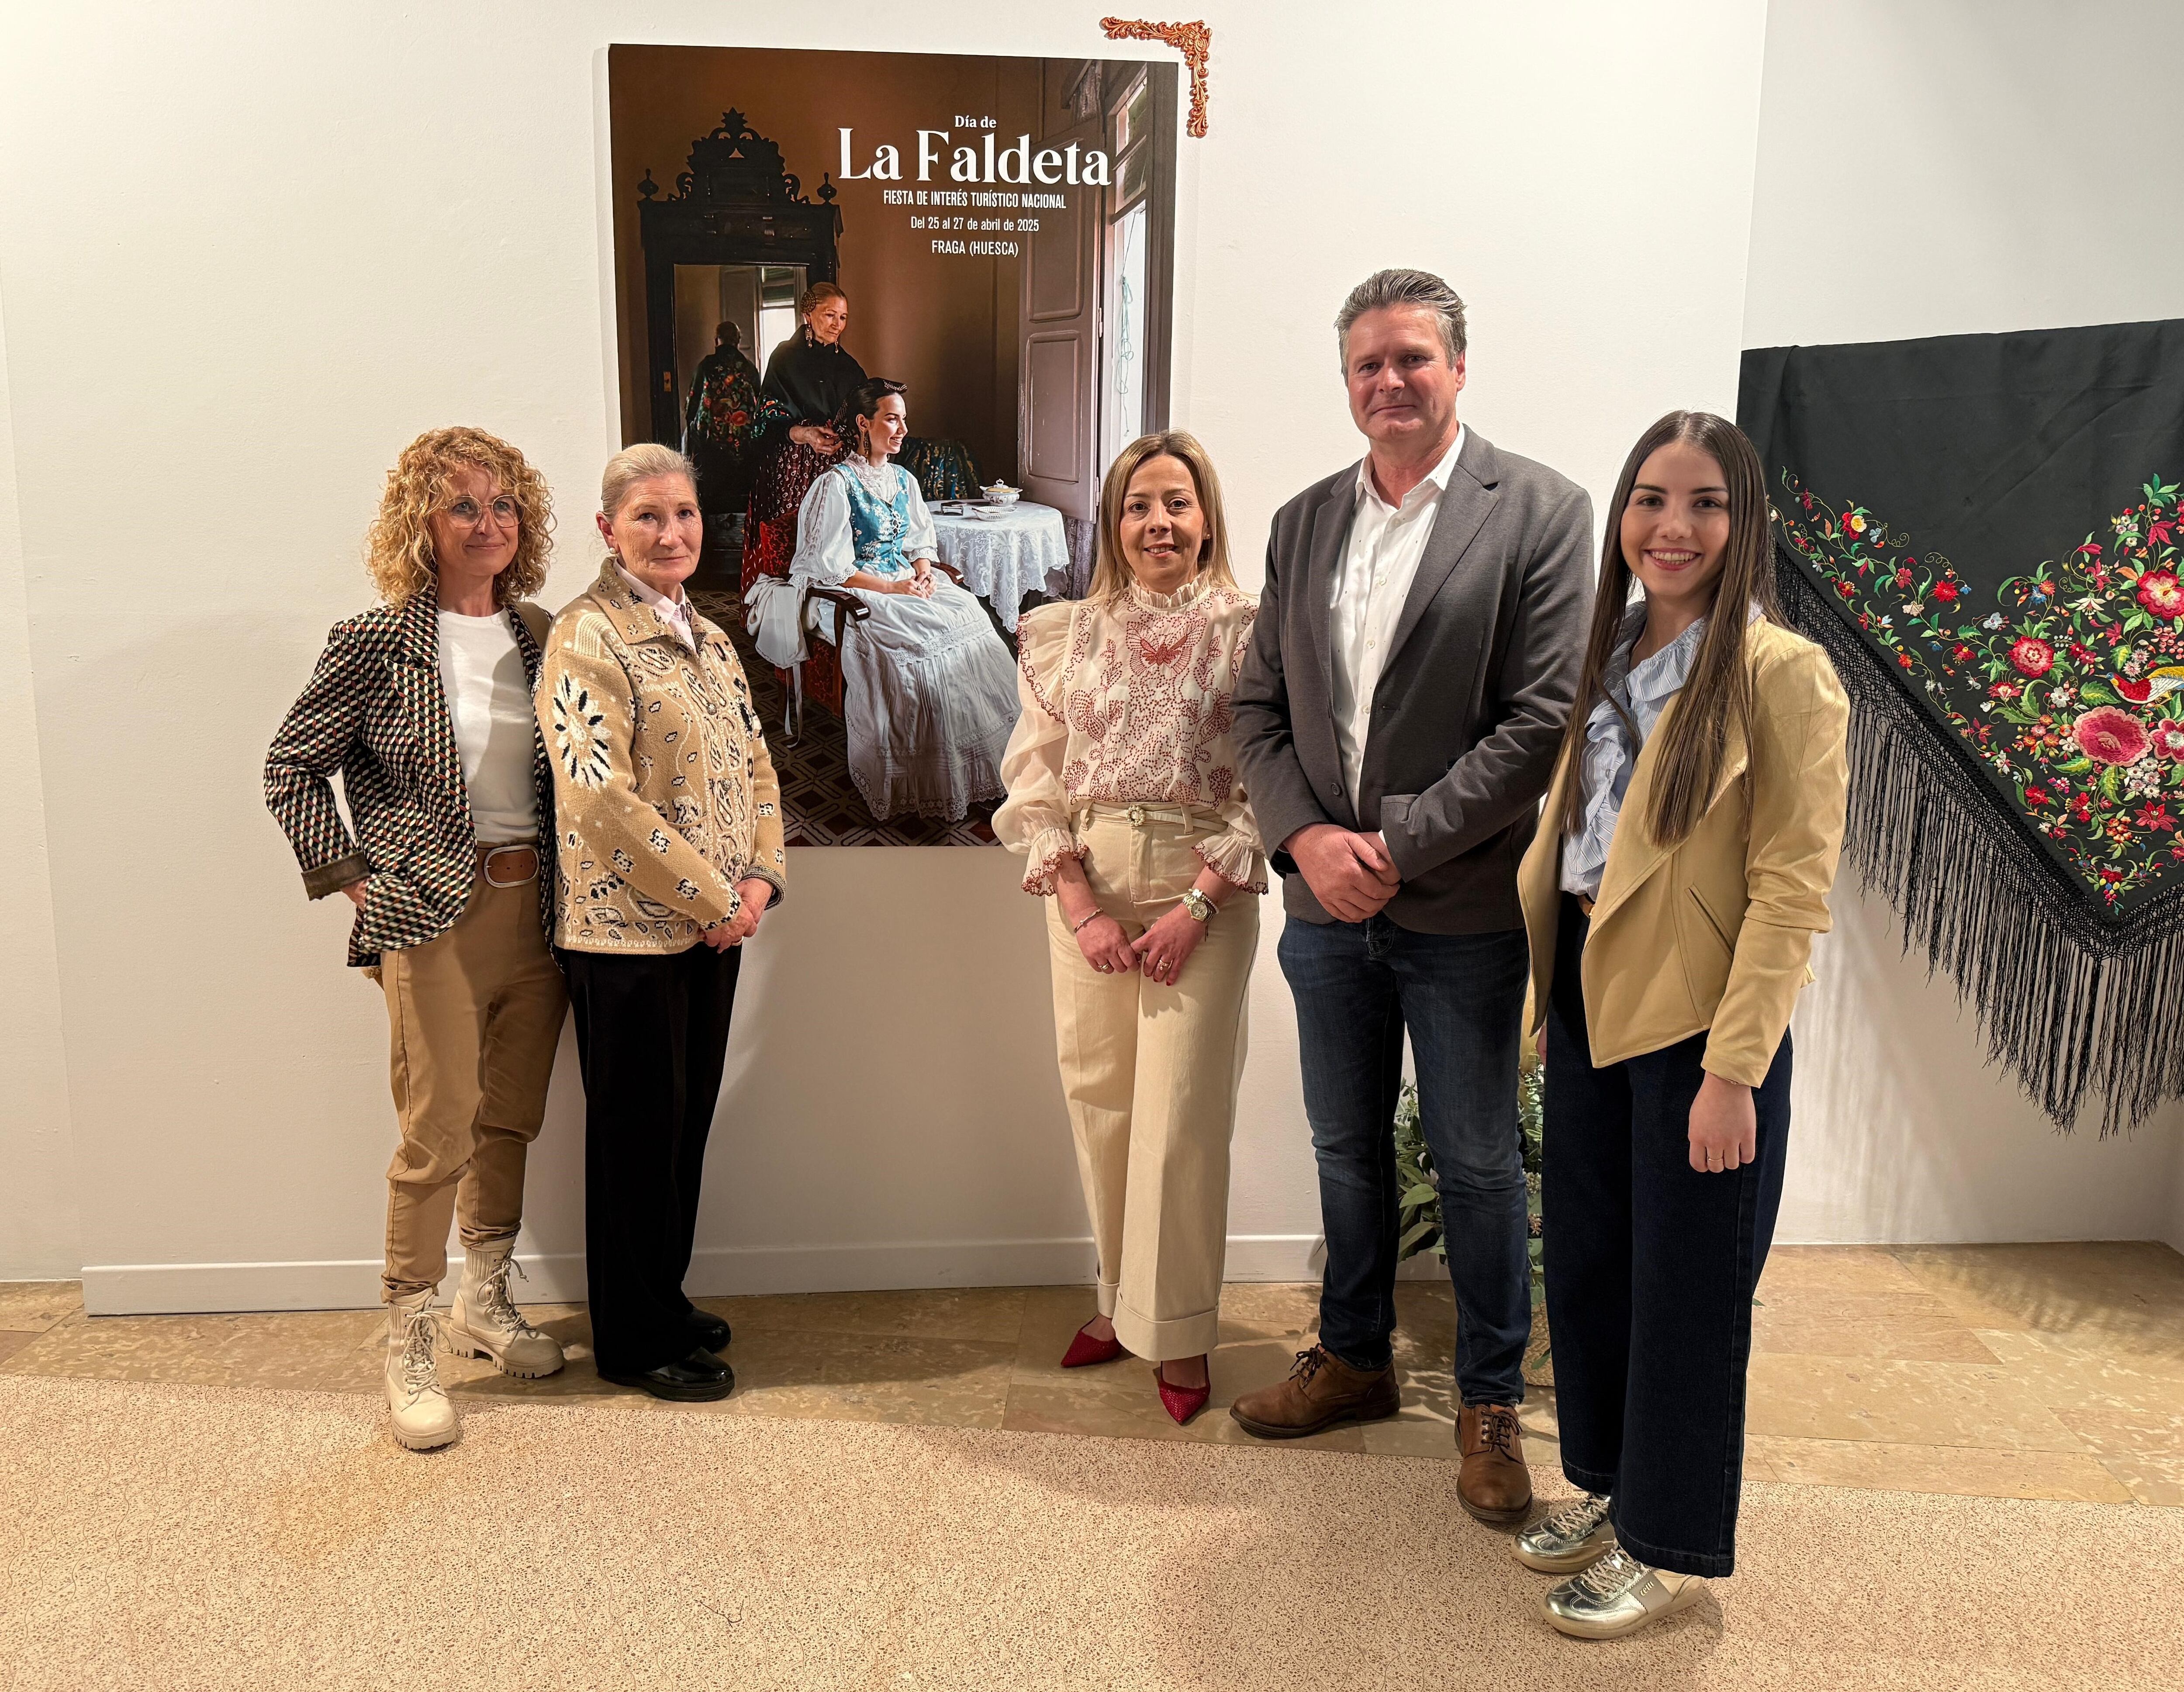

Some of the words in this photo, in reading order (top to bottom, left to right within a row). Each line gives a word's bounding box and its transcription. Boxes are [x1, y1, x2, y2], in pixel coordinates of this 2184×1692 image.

[954, 115, 977, 128] Día
[980, 116, 997, 128] de
[838, 128, 903, 180] La
[916, 130, 1112, 186] Faldeta
[883, 190, 914, 205] FIESTA
[917, 191, 928, 205] DE
[931, 188, 968, 207] INTERÉS
[970, 189, 1018, 207] TURÍSTICO
[1022, 193, 1067, 209] NACIONAL
[911, 216, 925, 229] Del
[928, 217, 939, 229] 25
[942, 217, 950, 229] al
[954, 217, 964, 229] 27
[967, 218, 978, 230] de
[981, 218, 1000, 231] abril
[1003, 218, 1014, 231] de
[1017, 219, 1039, 231] 2025
[932, 240, 966, 254] FRAGA
[969, 241, 1018, 258] (HUESCA)
